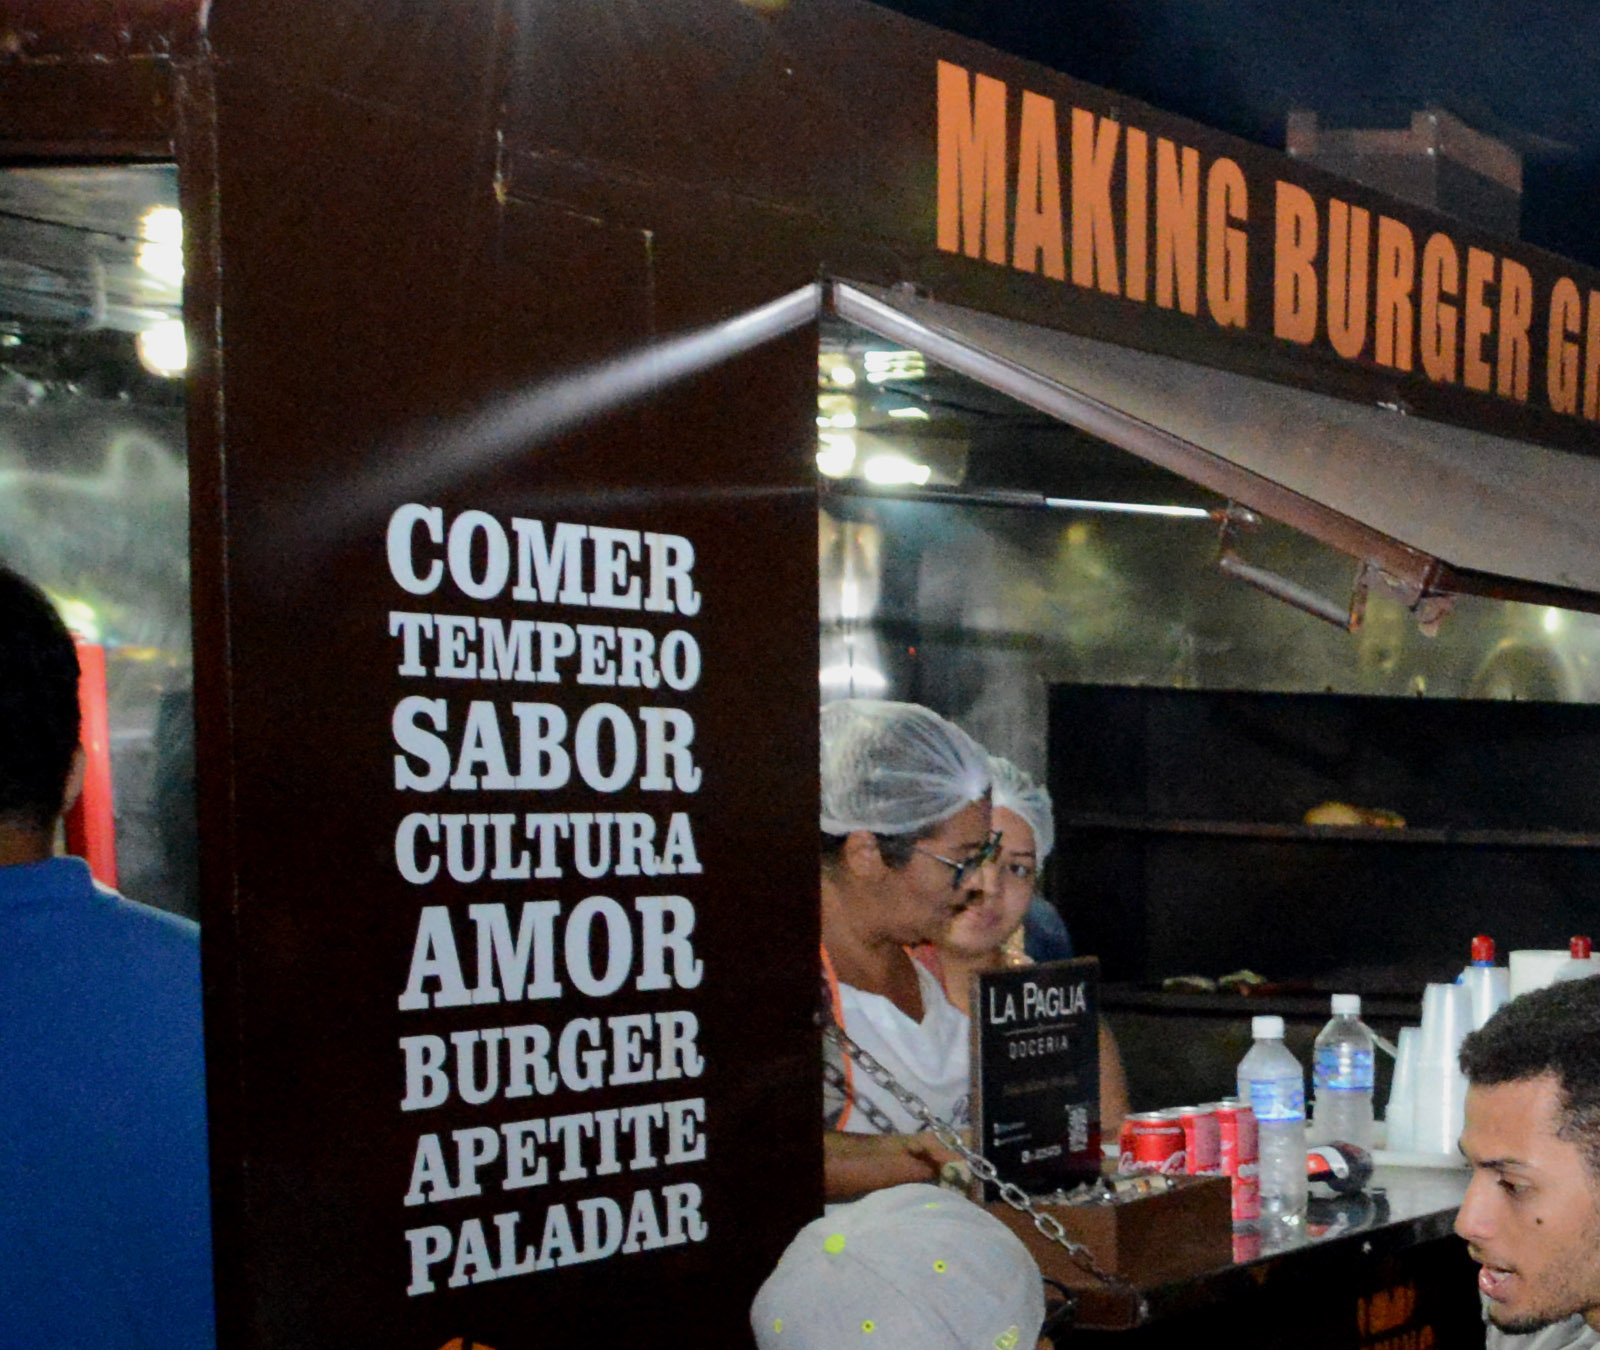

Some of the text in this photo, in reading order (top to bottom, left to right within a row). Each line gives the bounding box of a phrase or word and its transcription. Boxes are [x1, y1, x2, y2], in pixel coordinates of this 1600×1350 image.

[936, 60, 1249, 329] MAKING
[1273, 180, 1534, 404] BURGER
[386, 503, 701, 616] COMER
[389, 611, 702, 691] TEMPERO
[392, 696, 702, 795] SABOR
[395, 811, 702, 884] CULTURA
[398, 895, 703, 1011] AMOR
[400, 1010, 704, 1112] BURGER
[1009, 1035, 1069, 1060] DOCERIA
[404, 1098, 707, 1207] APETITE
[405, 1182, 708, 1297] PALADAR
